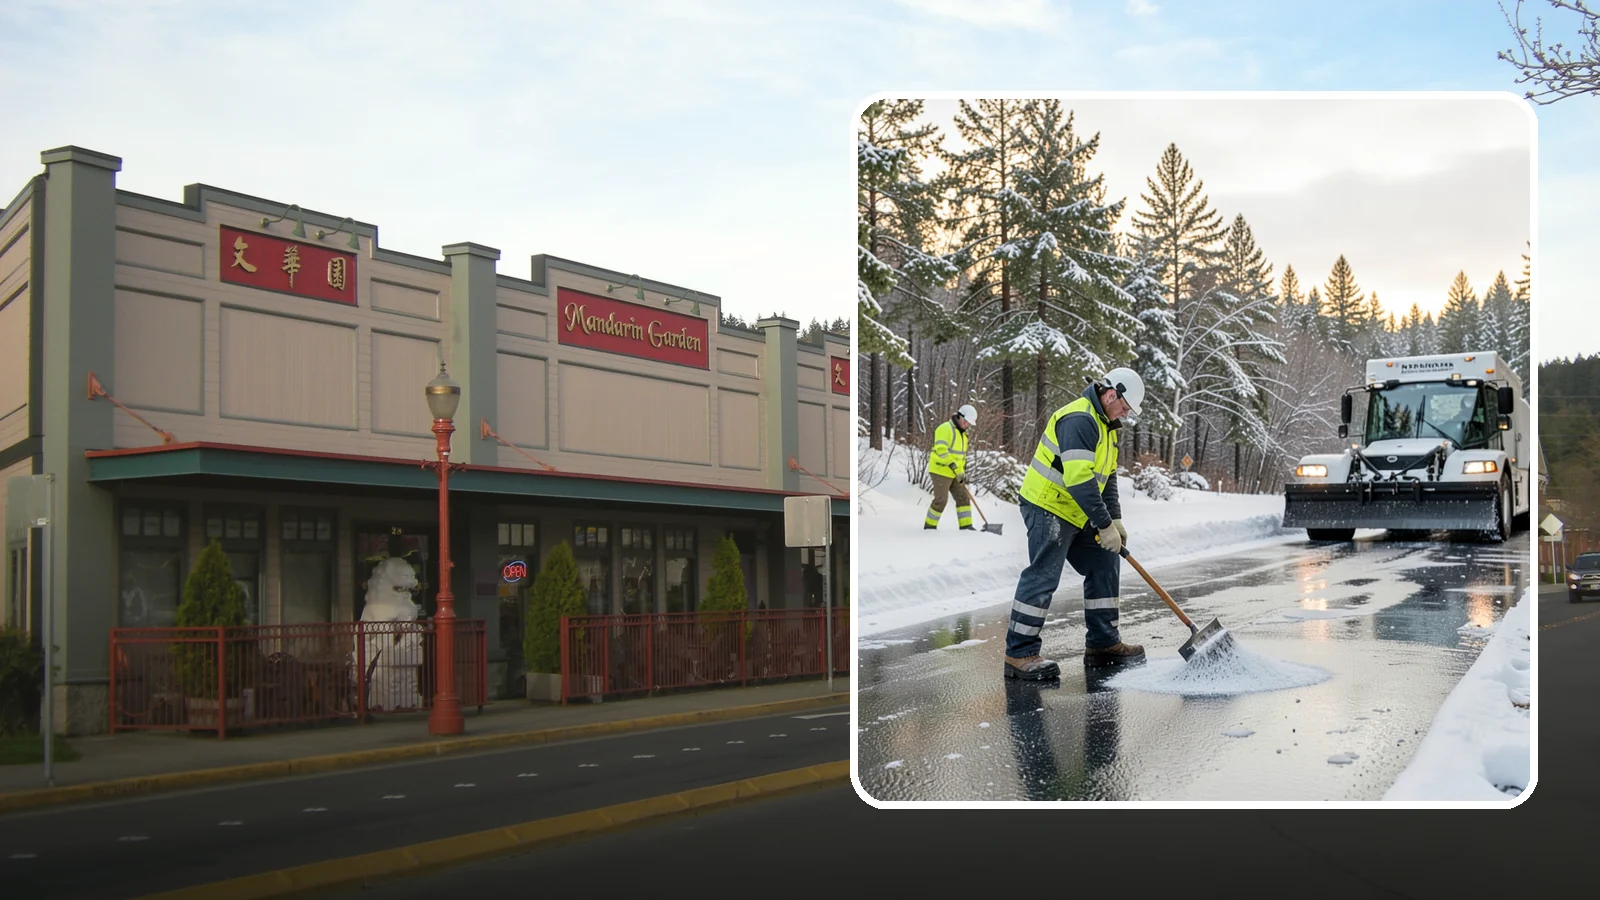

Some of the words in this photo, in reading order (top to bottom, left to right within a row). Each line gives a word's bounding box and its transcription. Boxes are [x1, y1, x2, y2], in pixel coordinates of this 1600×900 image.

[230, 235, 346, 291] 文華園
[564, 302, 644, 340] Mandarin
[648, 320, 701, 352] Garden
[503, 565, 527, 578] OPEN
